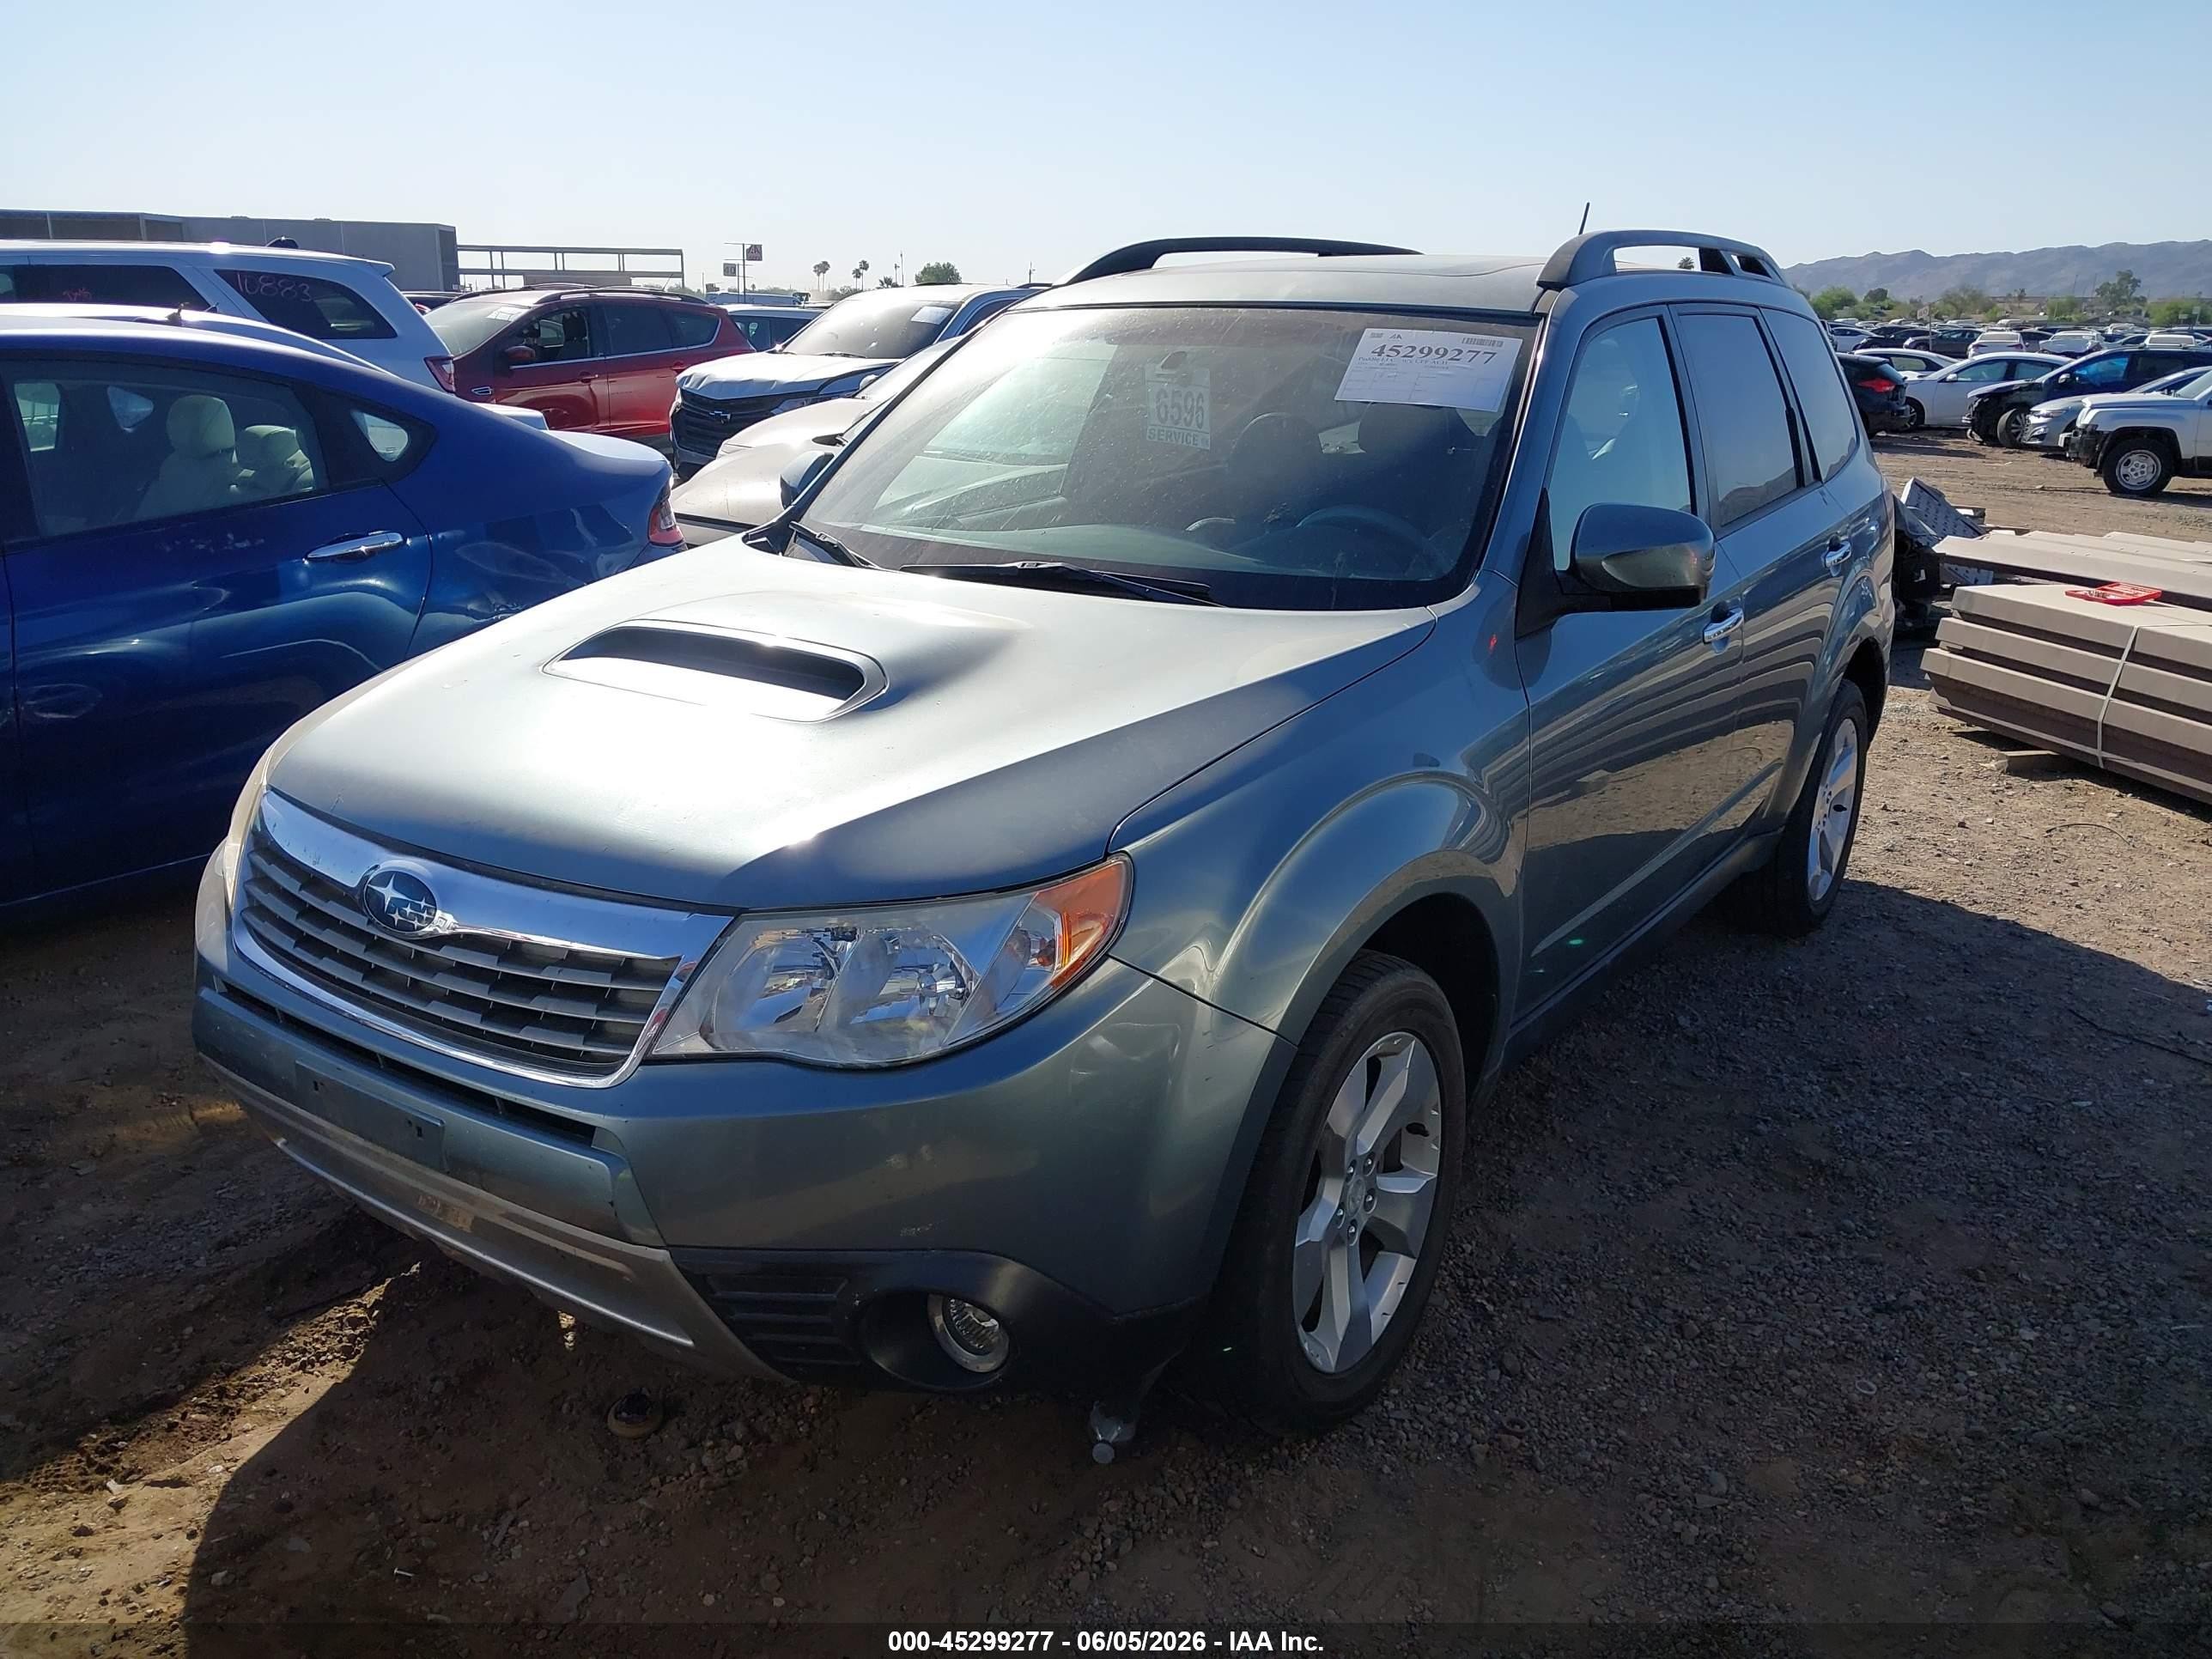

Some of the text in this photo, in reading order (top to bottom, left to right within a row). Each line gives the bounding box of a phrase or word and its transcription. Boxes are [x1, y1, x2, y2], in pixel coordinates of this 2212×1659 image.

[237, 271, 313, 301] 10883
[1371, 343, 1497, 365] 45299277
[1155, 388, 1205, 430] 6596
[1147, 428, 1199, 447] SERVICE
